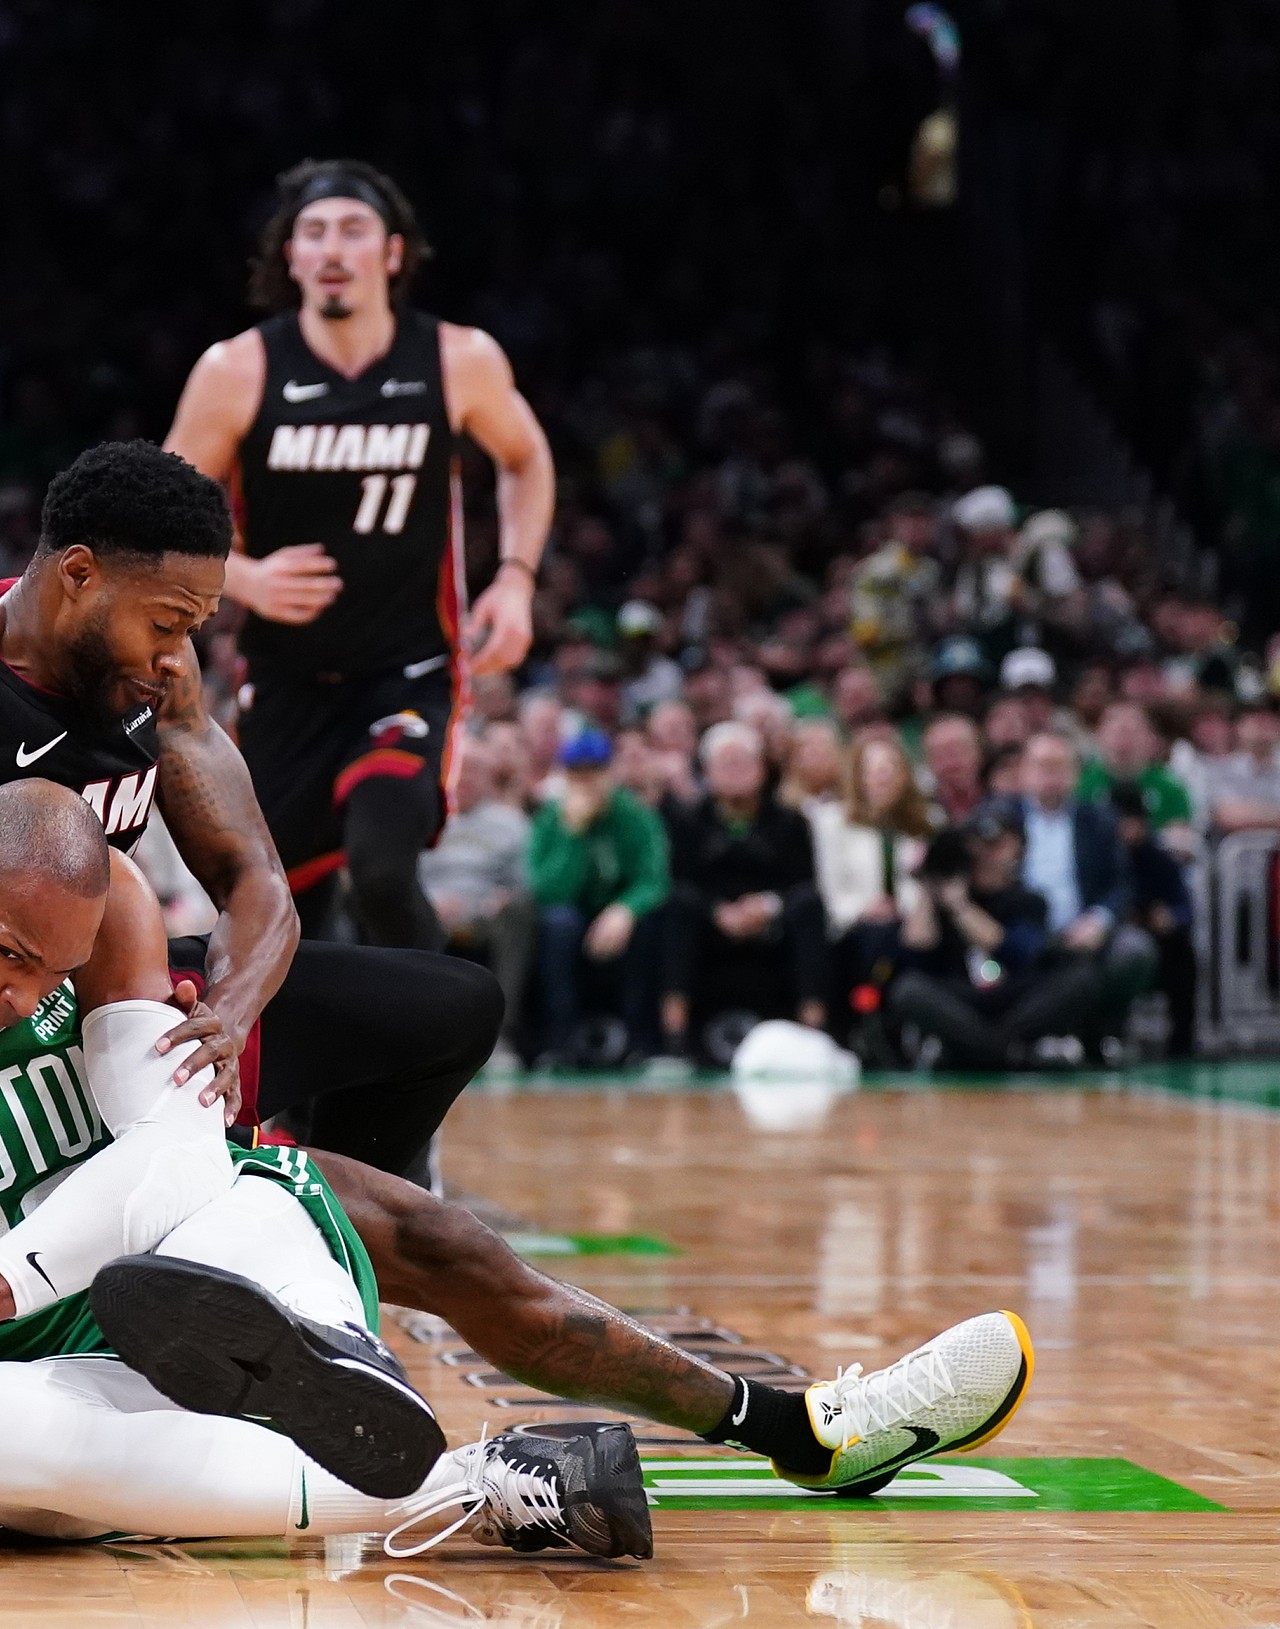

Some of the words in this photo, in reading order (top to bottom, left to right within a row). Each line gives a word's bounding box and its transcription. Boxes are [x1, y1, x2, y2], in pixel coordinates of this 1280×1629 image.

[267, 423, 431, 471] MIAMI
[352, 473, 417, 535] 11
[34, 995, 74, 1042] PRINT
